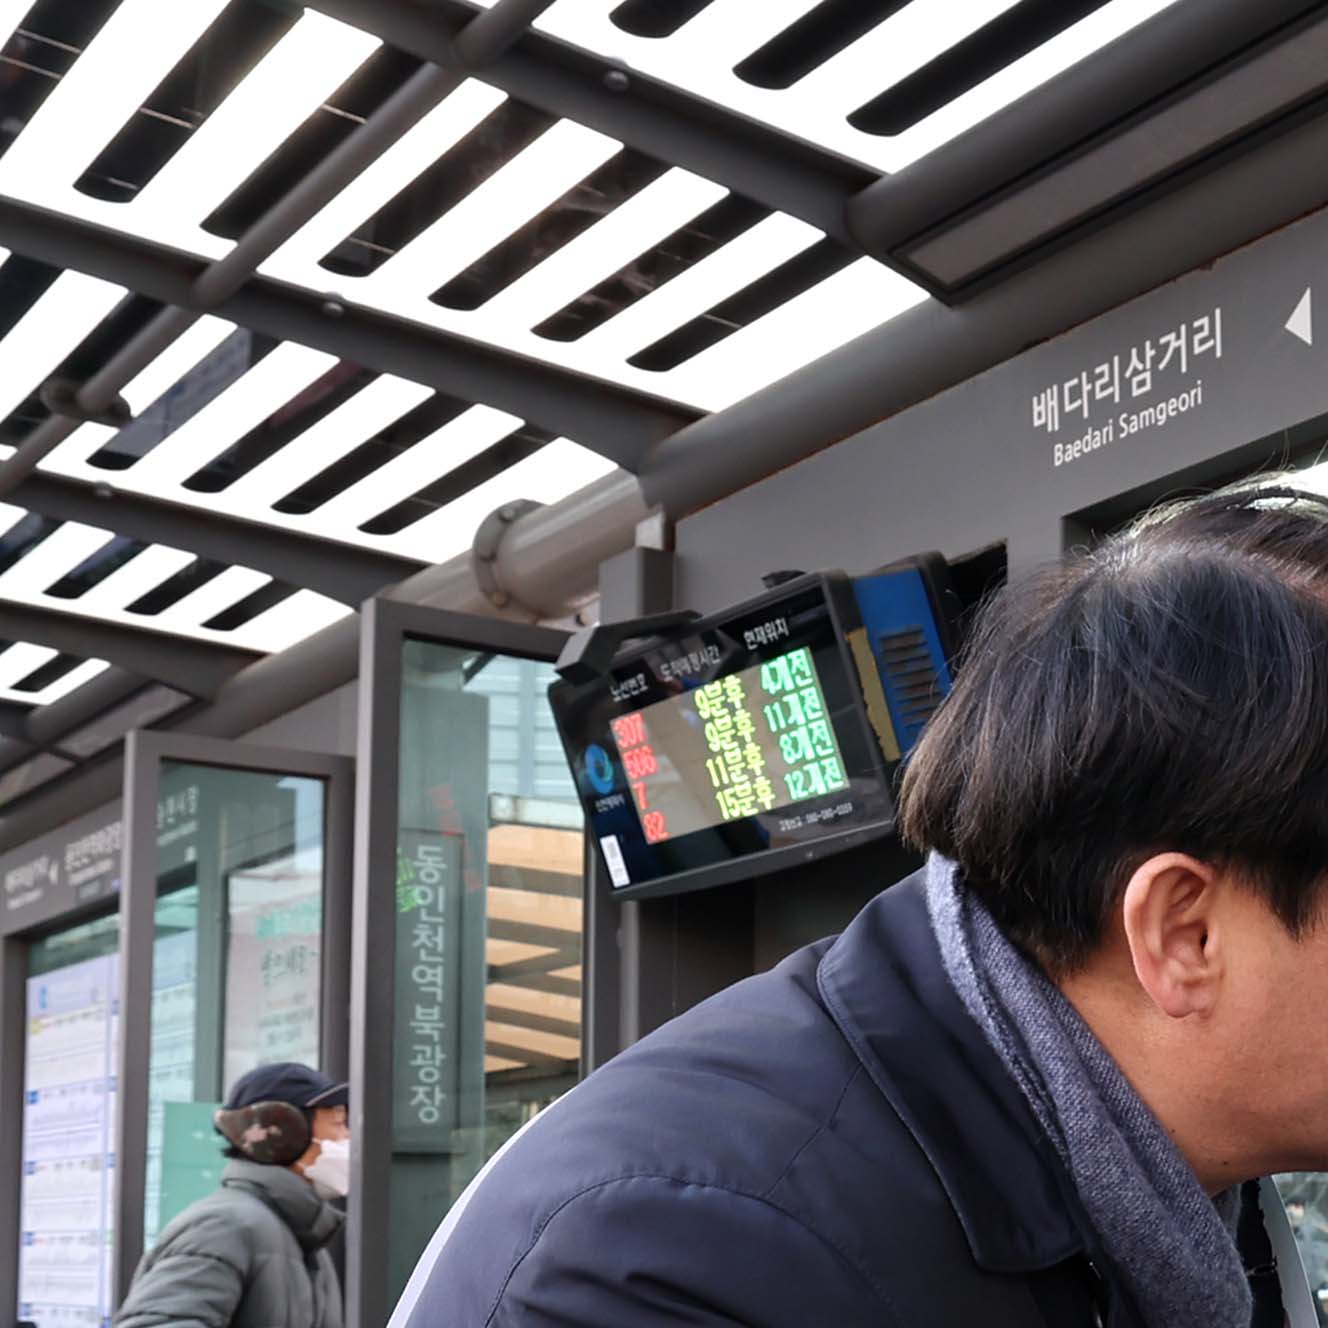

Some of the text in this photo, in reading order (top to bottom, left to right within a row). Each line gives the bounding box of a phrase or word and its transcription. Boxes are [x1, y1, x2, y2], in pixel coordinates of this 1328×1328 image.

[1031, 306, 1223, 433] 배다리삼거리
[1053, 379, 1203, 467] Baedari Samgeori
[742, 616, 790, 651] 현재위치
[694, 673, 746, 720] 9분후
[760, 647, 814, 695] 4개전
[704, 708, 757, 753] 9분후
[763, 685, 824, 733] 11개전
[705, 741, 766, 788] 11분후
[779, 718, 835, 765] 8개전
[715, 775, 776, 821] 15분후
[783, 756, 845, 801] 12개전
[409, 844, 448, 1125] 동인천역북광장
